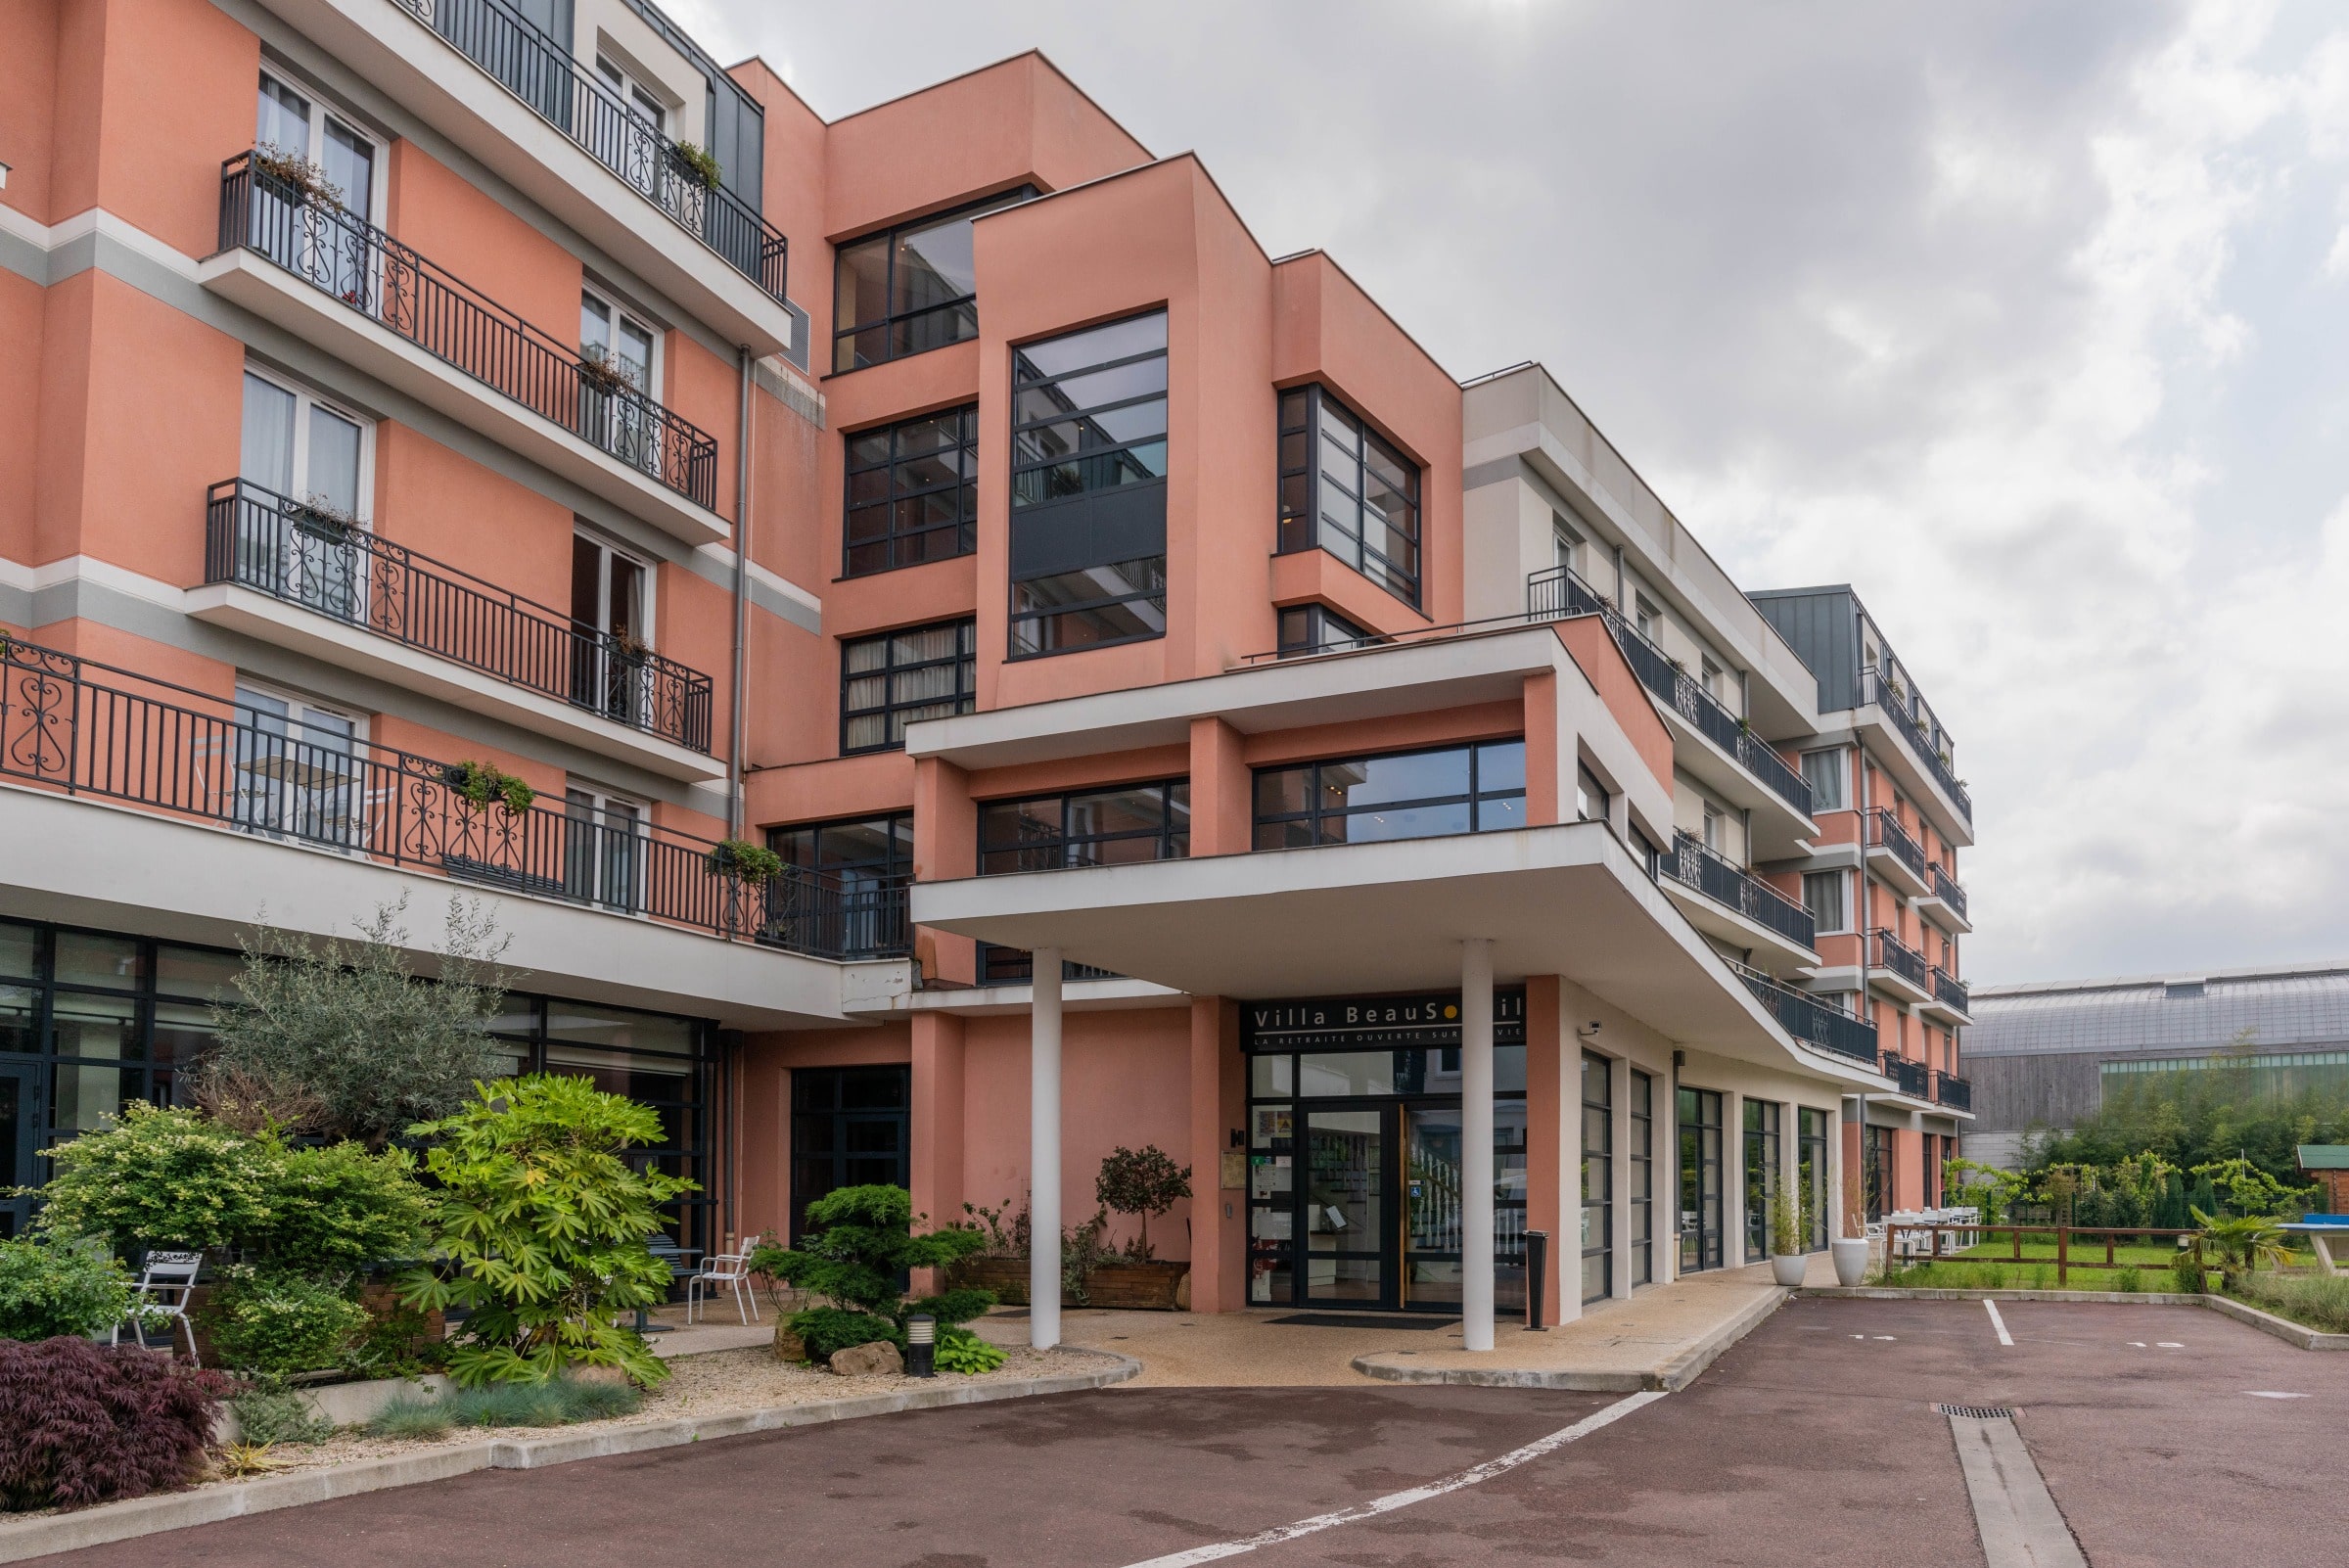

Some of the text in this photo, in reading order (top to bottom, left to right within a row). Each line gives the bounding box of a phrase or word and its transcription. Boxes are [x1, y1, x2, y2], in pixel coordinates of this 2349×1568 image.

[1255, 997, 1521, 1028] Villa BeauSoil
[1279, 1036, 1345, 1044] RETRAITE
[1357, 1033, 1420, 1041] OUVERTE
